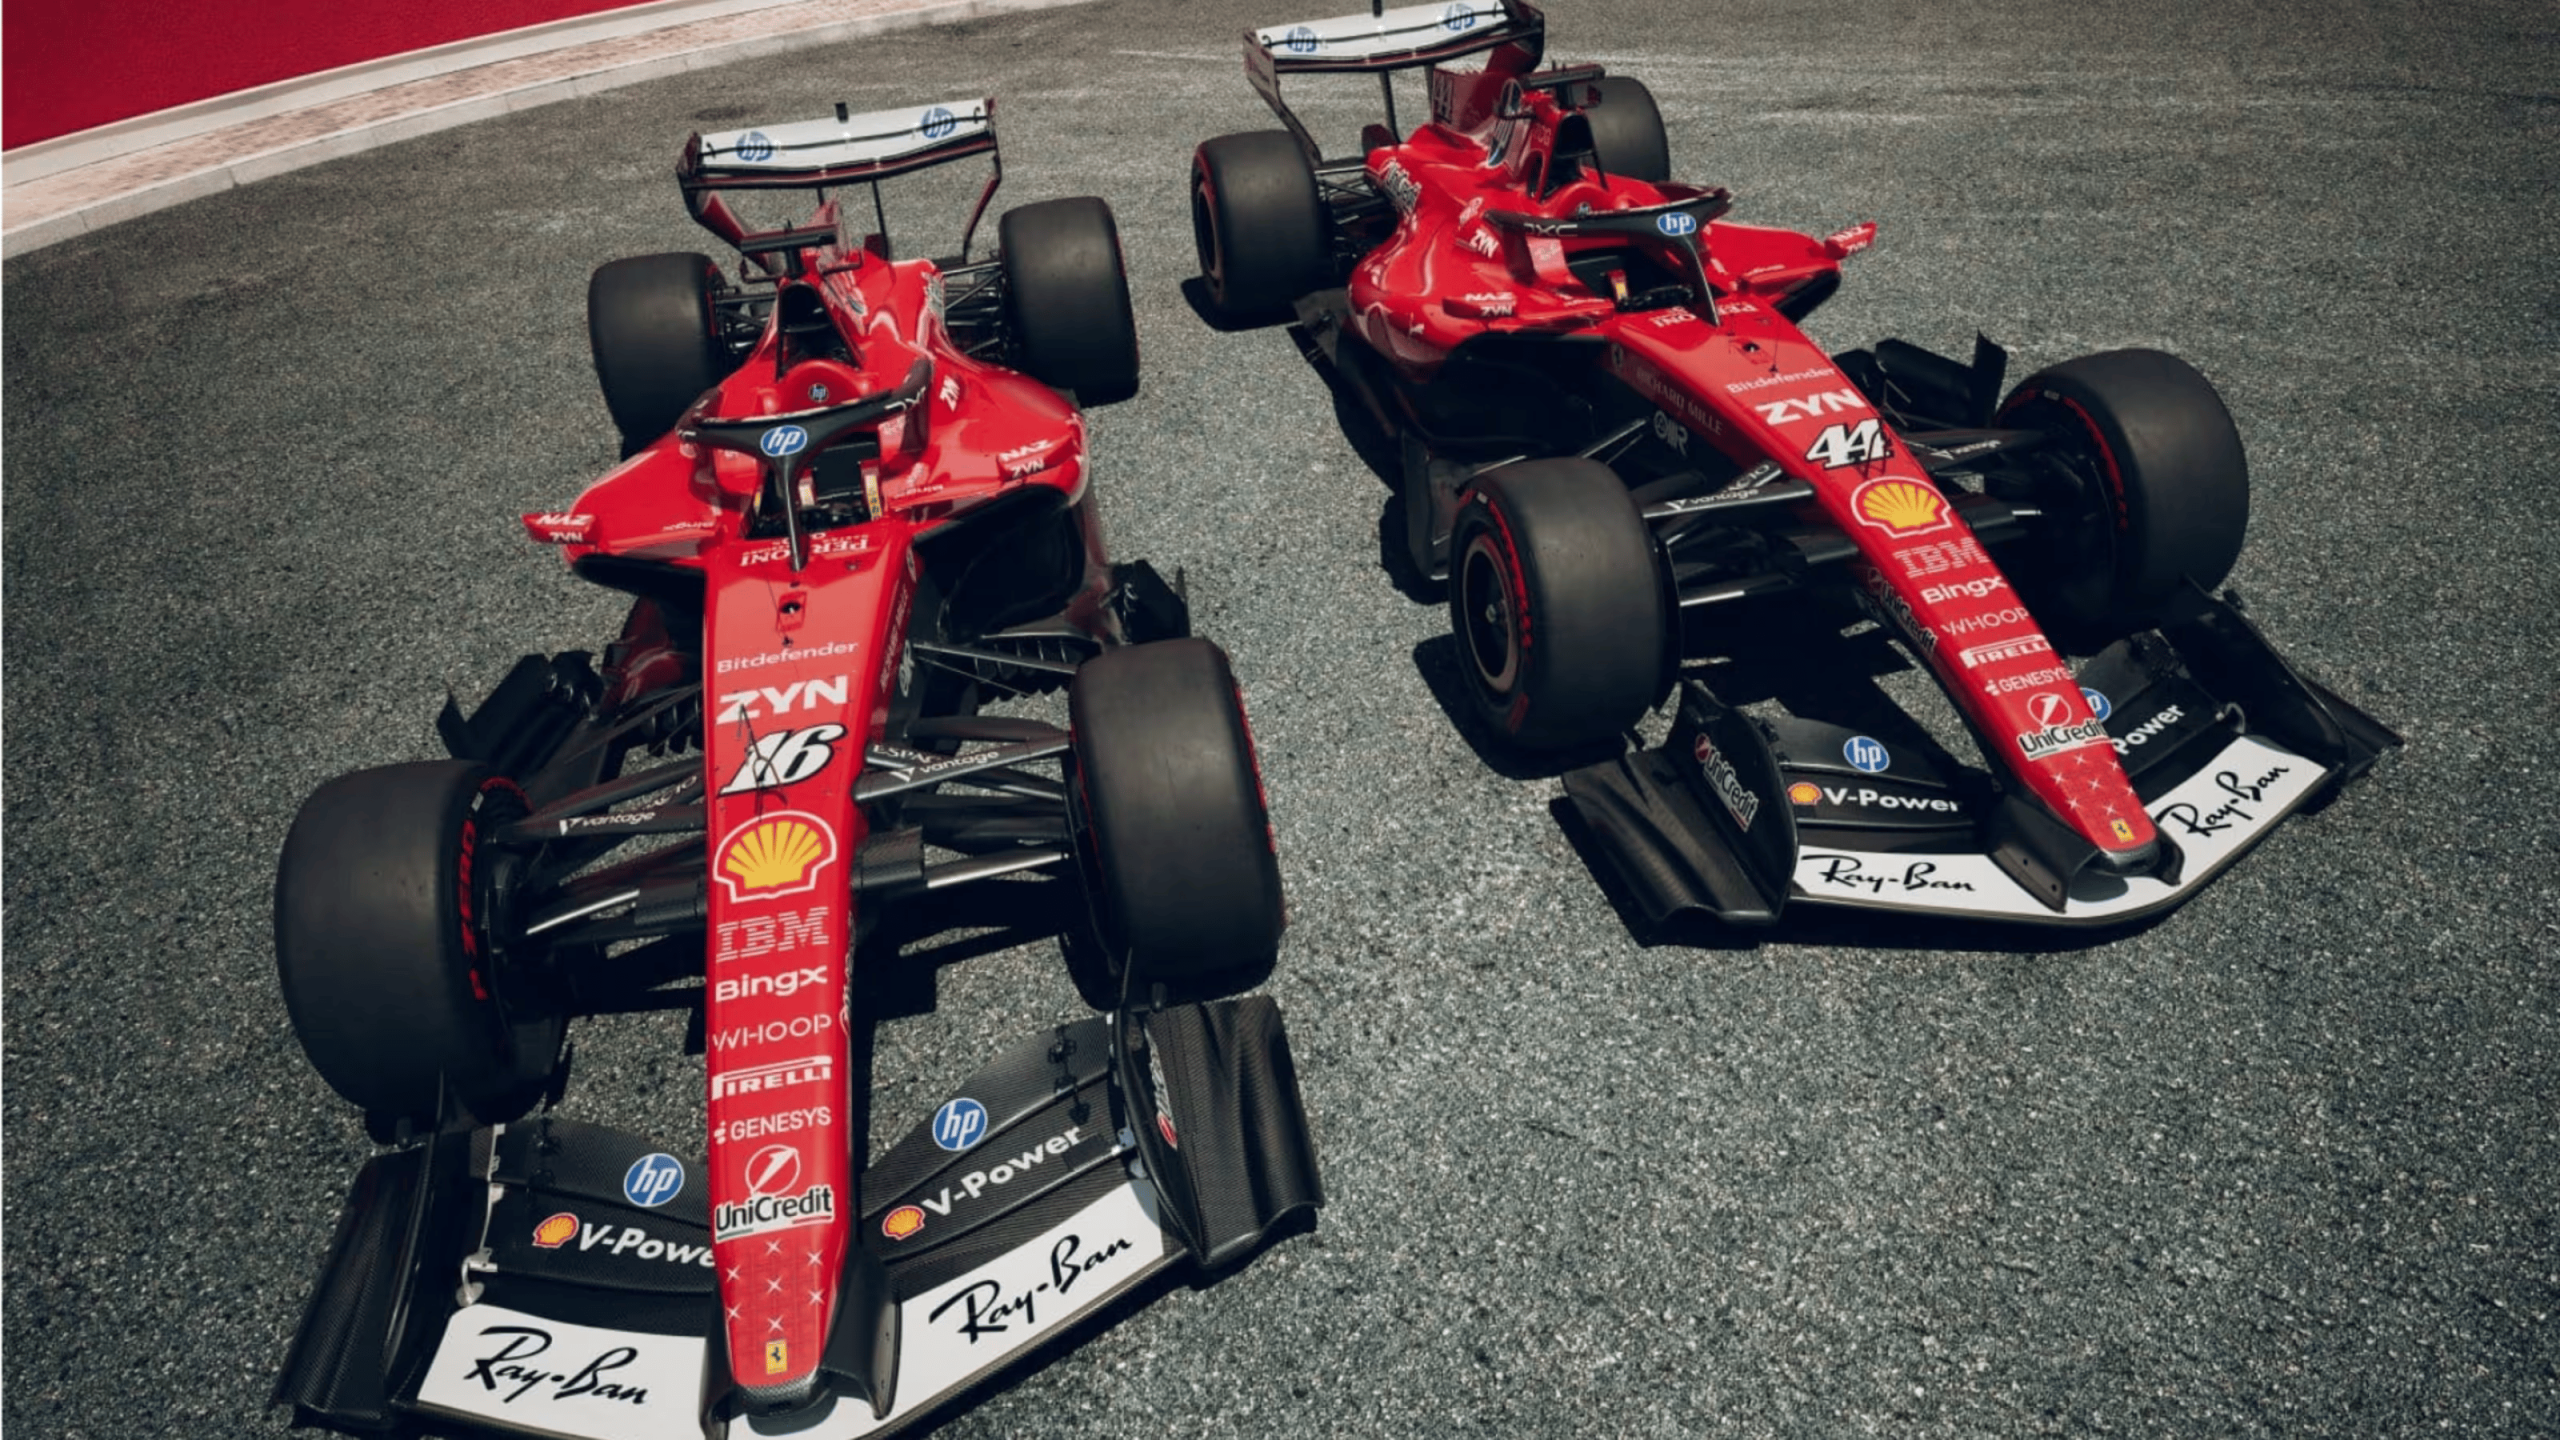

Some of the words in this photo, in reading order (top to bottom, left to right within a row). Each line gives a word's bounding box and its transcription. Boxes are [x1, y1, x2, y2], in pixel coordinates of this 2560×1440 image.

[1665, 214, 1690, 234] hp
[1726, 367, 1836, 394] Bitdefender
[1755, 389, 1867, 425] ZYN
[767, 426, 804, 455] hp
[1804, 417, 1894, 471] 44
[1892, 537, 1993, 579] IBM
[716, 640, 860, 674] Bitdefender
[716, 675, 849, 725] ZYN
[717, 723, 848, 797] 16
[919, 752, 999, 774] vantage
[1852, 737, 1883, 772] hp
[1705, 751, 1758, 822] UniCredit
[2155, 766, 2290, 838] Ray-Ban
[582, 810, 657, 825] vantage
[1801, 854, 1976, 893] Ray-Ban
[715, 906, 830, 963] IBM
[713, 1014, 832, 1052] WHOOP
[711, 1055, 833, 1100] PIRELLI
[730, 1107, 832, 1141] GENESYS
[941, 1099, 980, 1149] hp
[630, 1153, 679, 1207] hp
[922, 1125, 1082, 1216] V-Power
[716, 1187, 833, 1232] UniCredit
[579, 1223, 716, 1268] V-Powe
[928, 1234, 1133, 1345] Ray-Ban
[463, 1326, 648, 1404] Ray-Ban
